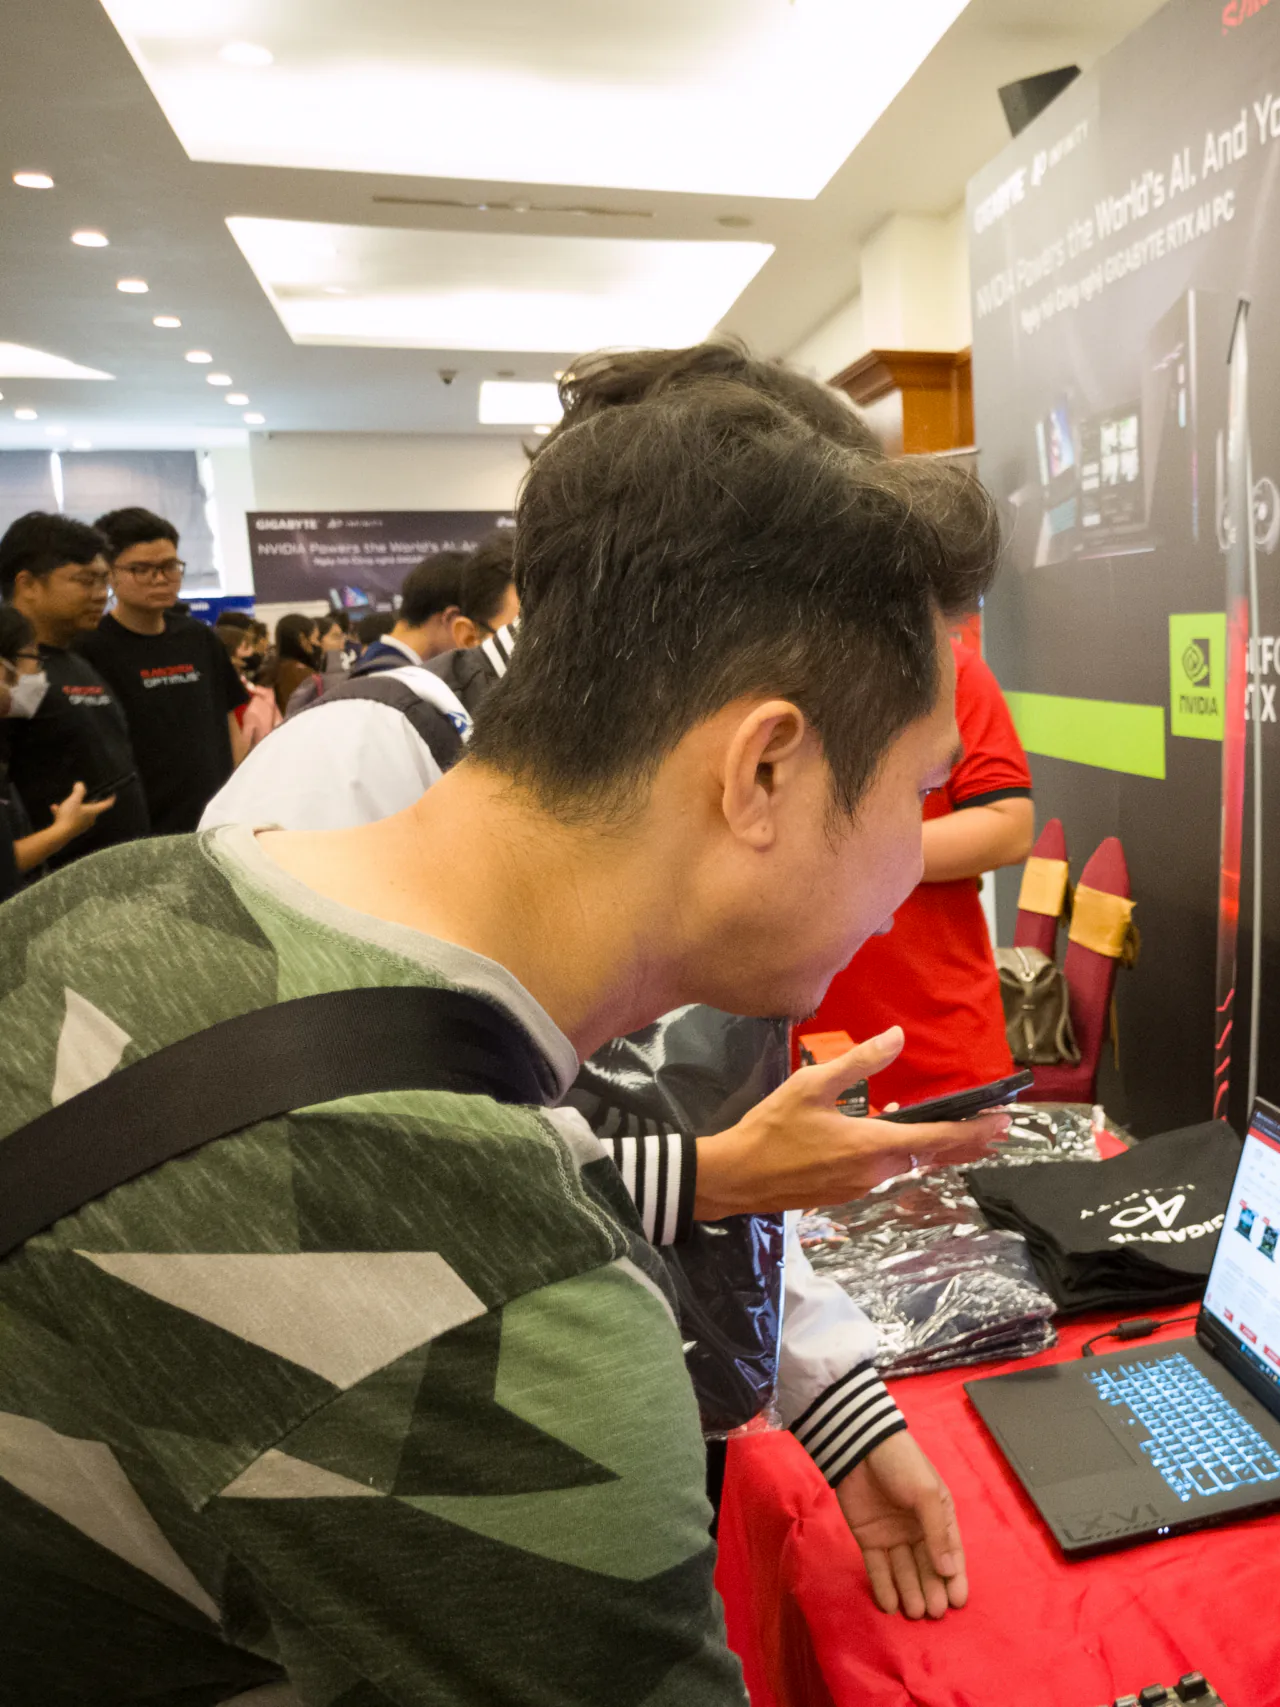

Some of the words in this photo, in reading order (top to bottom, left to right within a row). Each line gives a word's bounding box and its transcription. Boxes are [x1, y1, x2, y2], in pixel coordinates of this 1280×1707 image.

[1067, 217, 1094, 259] the
[1095, 169, 1164, 240] World's
[1168, 147, 1197, 199] AI.
[1202, 107, 1248, 180] And
[1213, 189, 1236, 228] PC
[257, 542, 307, 556] NVIDIA
[310, 541, 363, 555] Powers
[364, 541, 388, 555] the
[389, 540, 440, 554] World's
